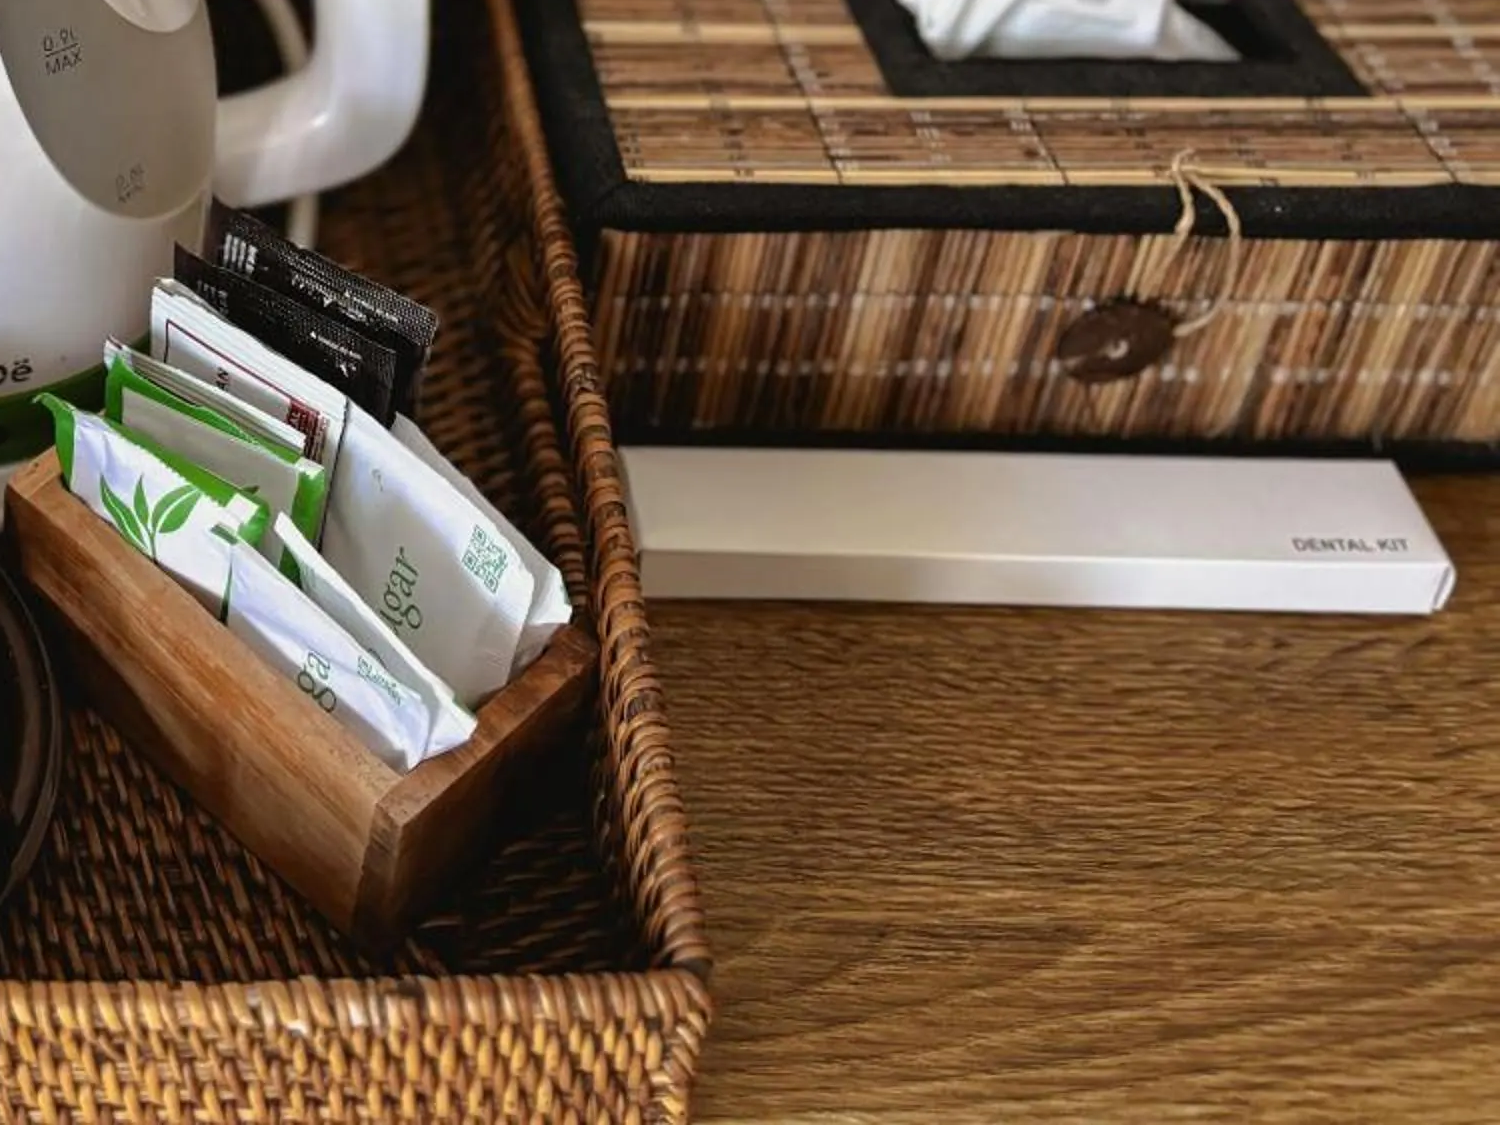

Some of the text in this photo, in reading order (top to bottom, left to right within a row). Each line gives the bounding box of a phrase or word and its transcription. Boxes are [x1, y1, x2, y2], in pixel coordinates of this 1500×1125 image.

[45, 46, 82, 76] MAX
[1291, 537, 1409, 553] DENTAL KIT
